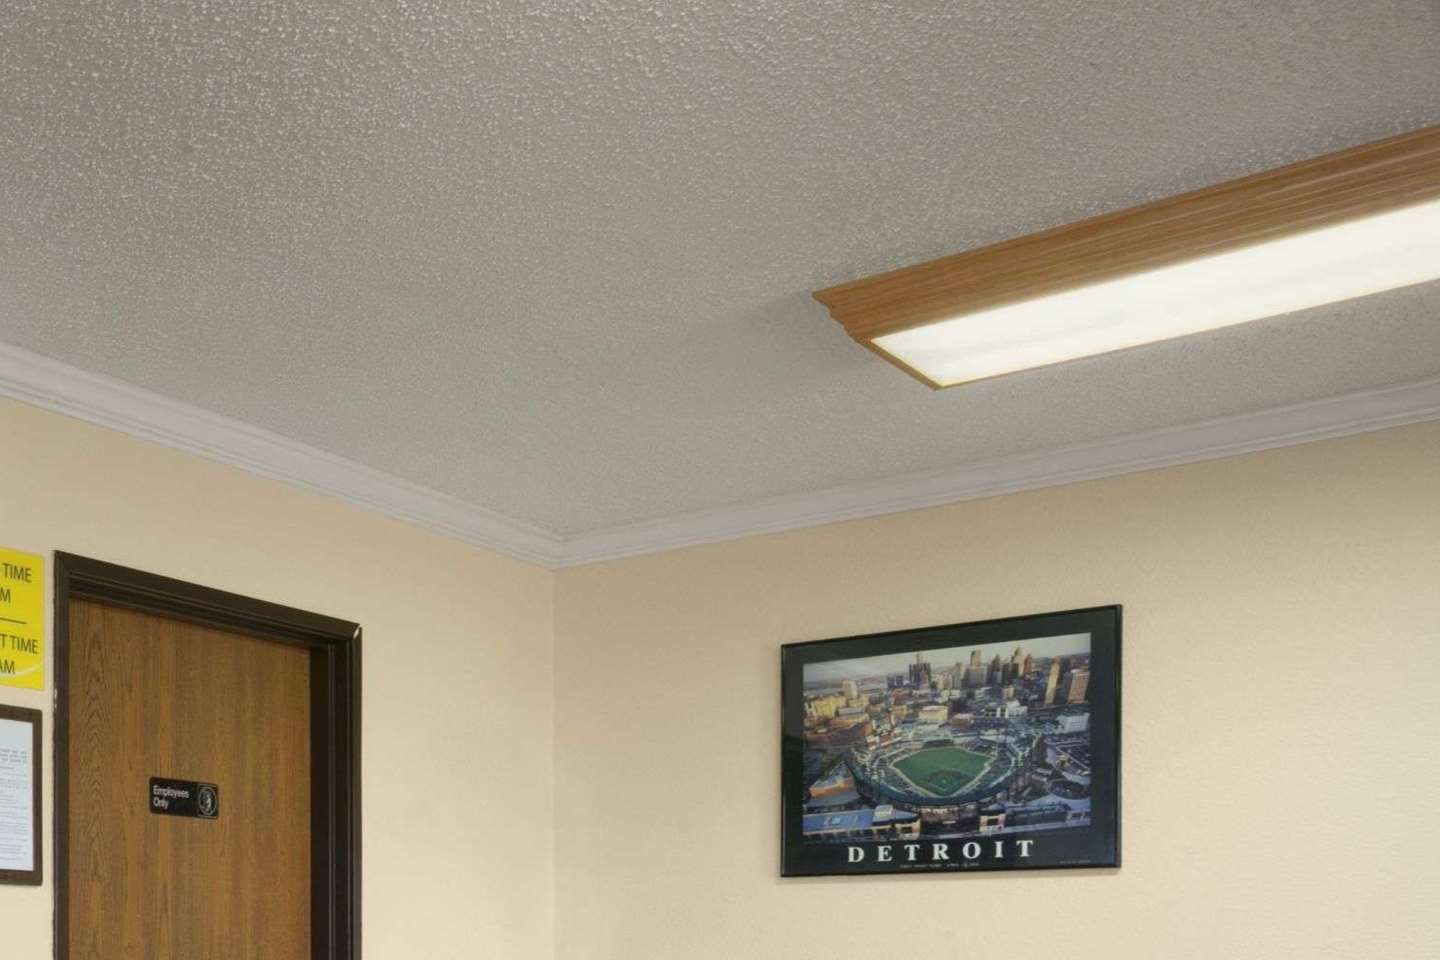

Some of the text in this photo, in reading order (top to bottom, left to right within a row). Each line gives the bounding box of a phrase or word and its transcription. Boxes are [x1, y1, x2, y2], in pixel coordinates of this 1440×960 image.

[2, 562, 33, 584] TIME
[10, 635, 39, 655] TIME
[152, 784, 190, 799] Employees
[152, 796, 169, 809] Only
[847, 839, 1034, 863] DETROIT
